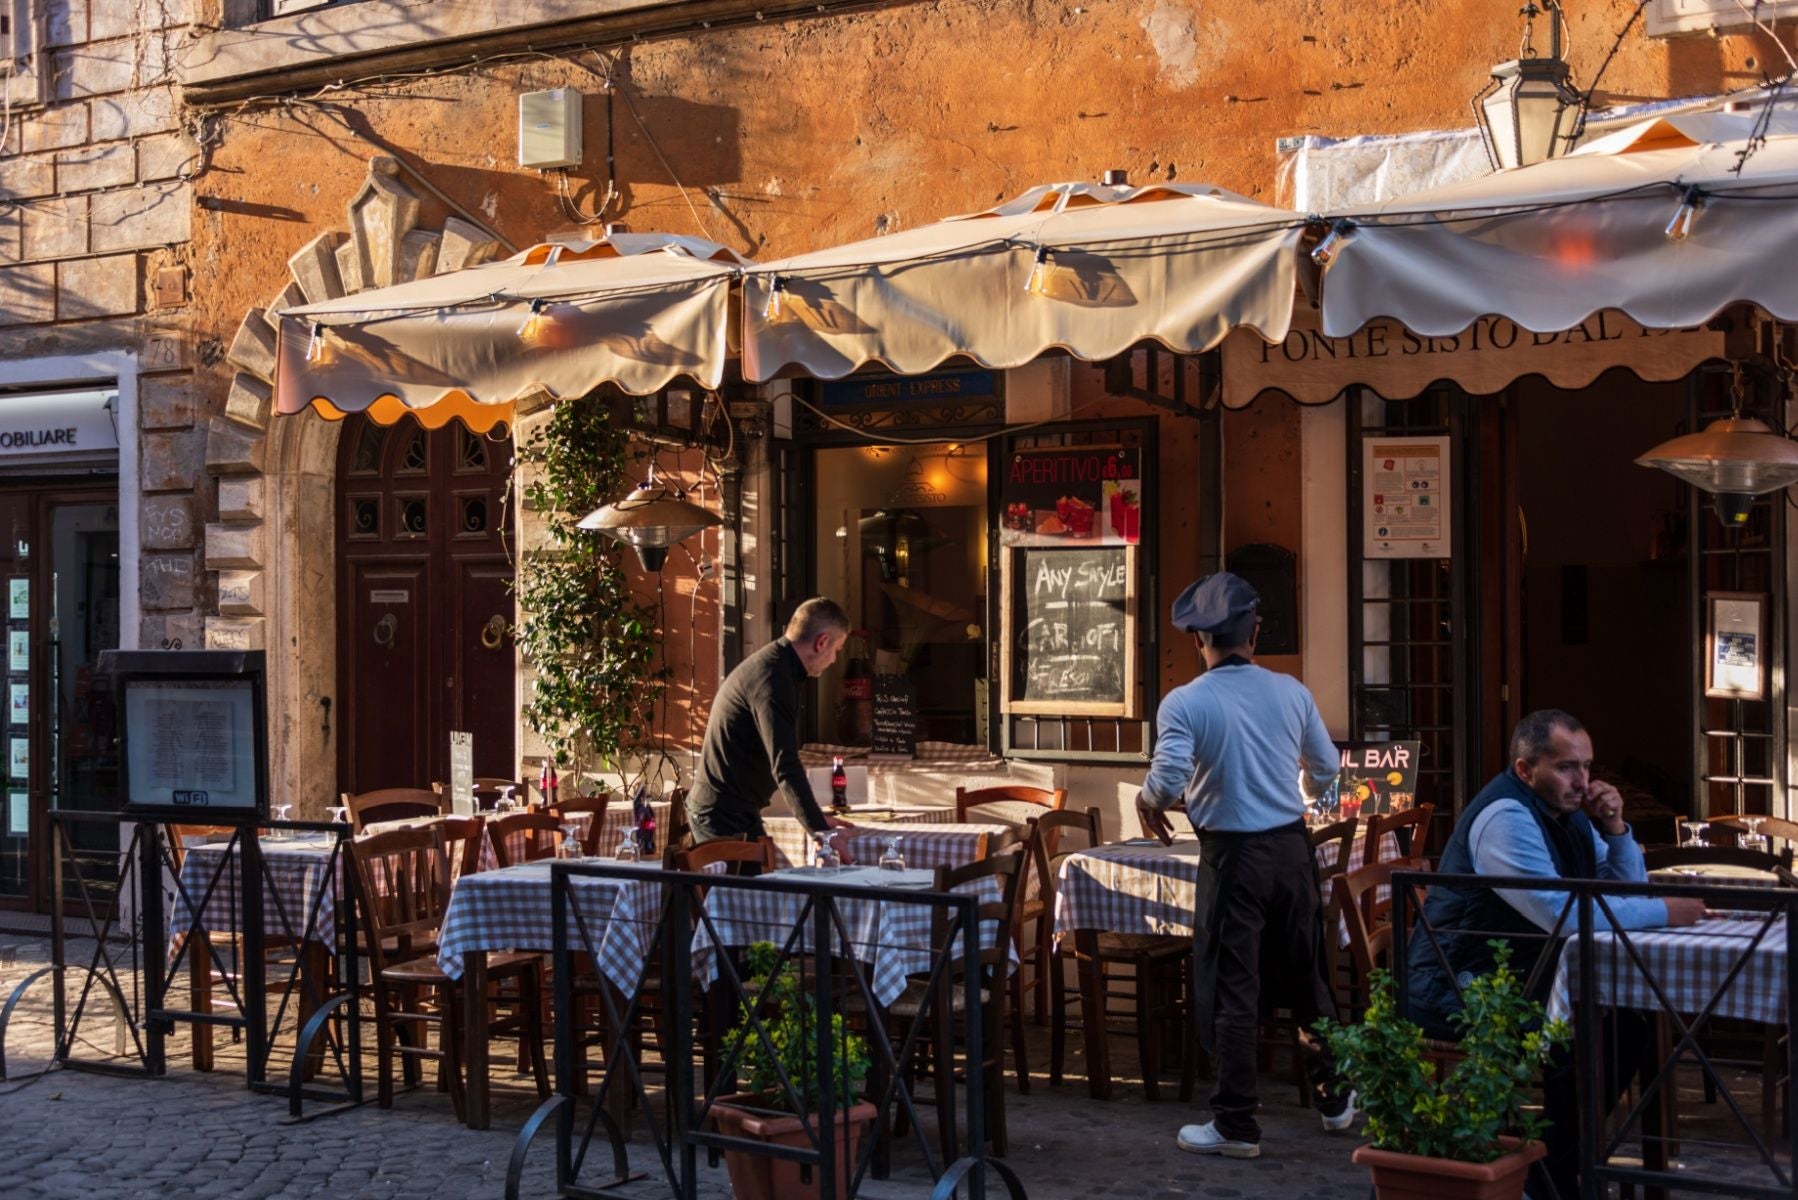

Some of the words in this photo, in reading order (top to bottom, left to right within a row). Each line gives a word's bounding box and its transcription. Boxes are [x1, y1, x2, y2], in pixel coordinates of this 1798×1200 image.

[150, 338, 175, 364] 78
[910, 378, 961, 396] EXPRESS
[0, 427, 77, 448] OBILIARE
[1009, 456, 1100, 483] APERITIVO
[1034, 558, 1072, 599] ANY
[1364, 749, 1410, 769] BAR
